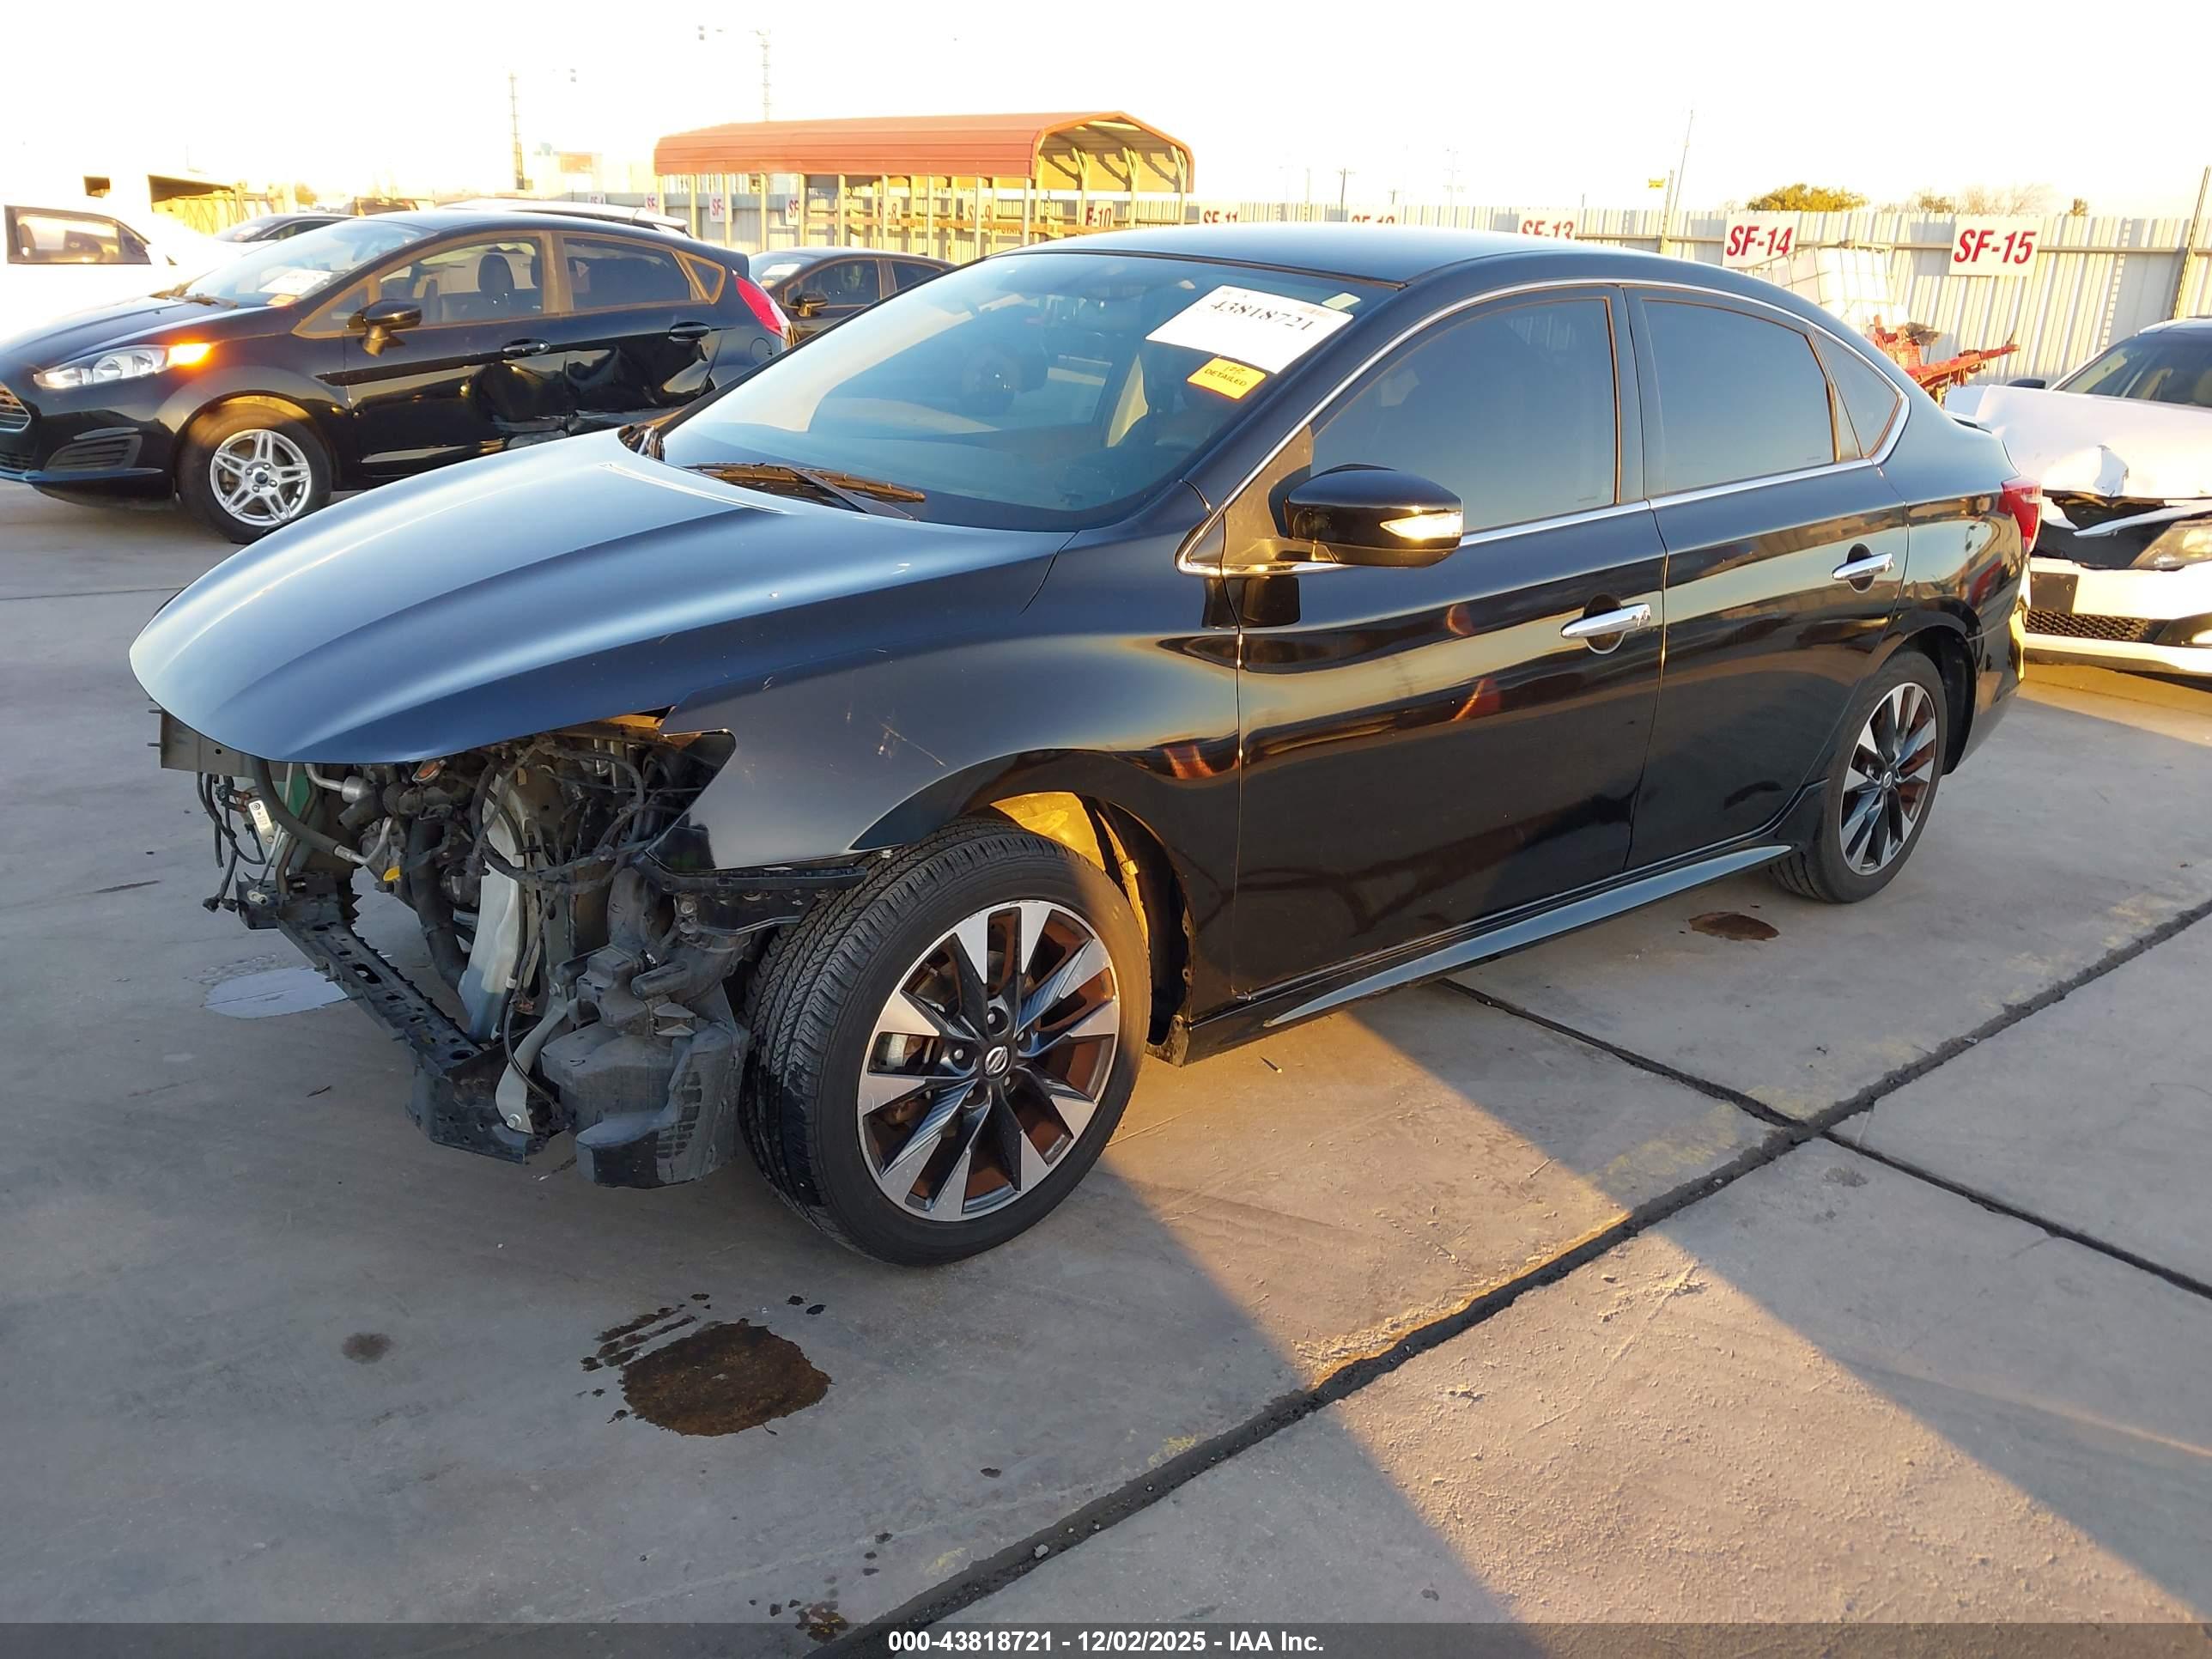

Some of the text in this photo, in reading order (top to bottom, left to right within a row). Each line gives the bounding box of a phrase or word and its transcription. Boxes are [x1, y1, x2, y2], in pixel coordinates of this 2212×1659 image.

[712, 198, 725, 216] SF-
[1726, 225, 1793, 257] SF-14
[1954, 228, 2038, 264] SF-15
[1211, 301, 1315, 331] 43818721
[1204, 368, 1247, 386] DETAILED
